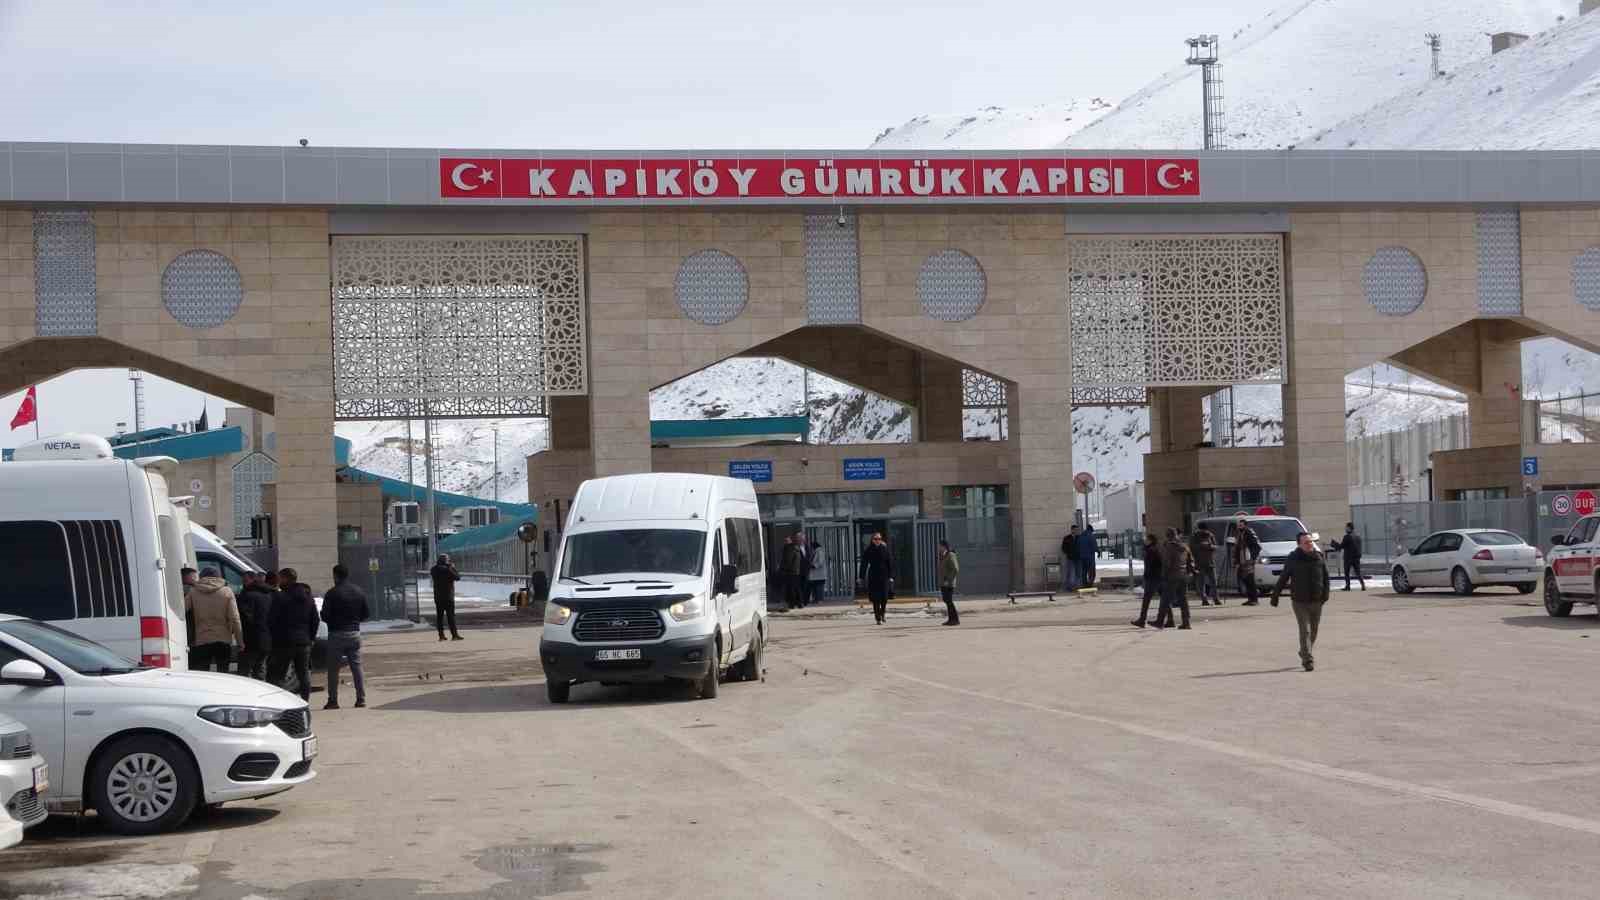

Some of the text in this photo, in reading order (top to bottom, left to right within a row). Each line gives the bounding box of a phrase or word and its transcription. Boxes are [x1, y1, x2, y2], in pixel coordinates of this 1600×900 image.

[528, 159, 1125, 196] KAPIKÖY GÜMRÜK KAPISI
[1525, 463, 1534, 474] 3
[1575, 498, 1595, 509] DUR
